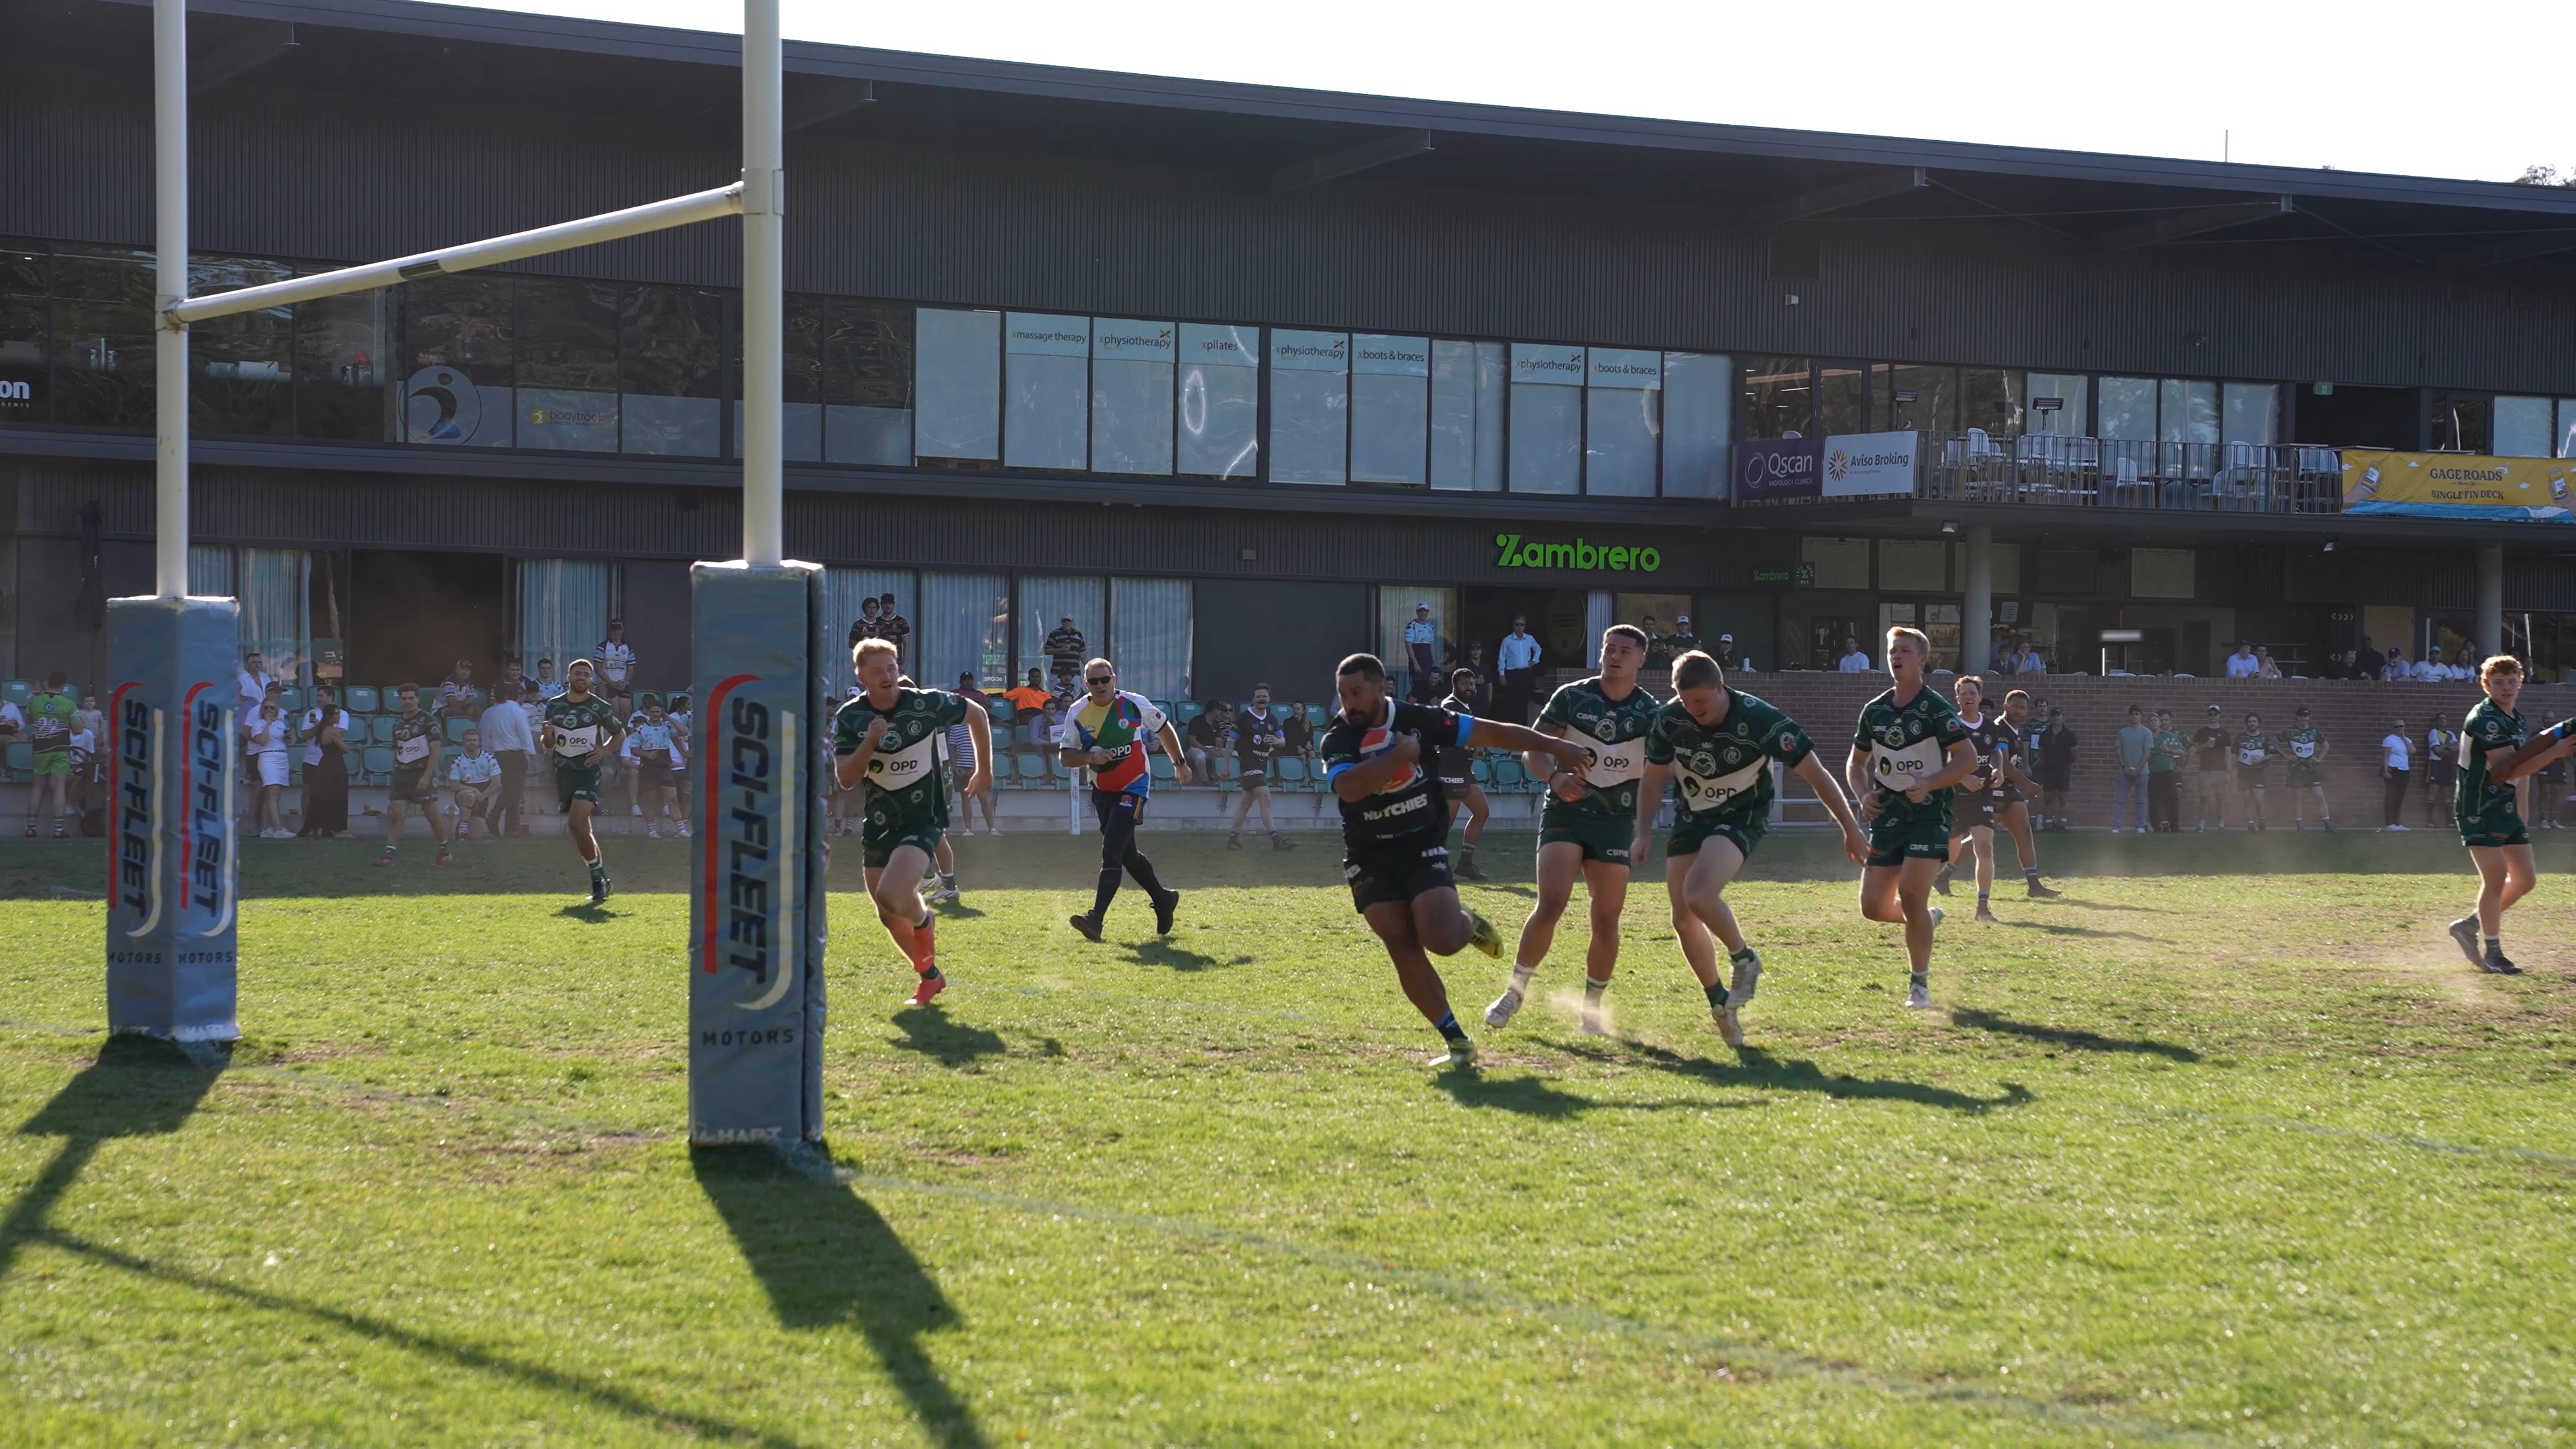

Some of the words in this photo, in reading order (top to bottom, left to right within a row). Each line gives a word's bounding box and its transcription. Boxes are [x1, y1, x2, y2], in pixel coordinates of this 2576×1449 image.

[1055, 331, 1087, 344] therapy
[1389, 351, 1396, 360] &
[1397, 350, 1425, 362] braces
[1622, 364, 1630, 374] &
[1631, 363, 1657, 376] braces
[1768, 452, 1813, 478] Qscan
[1850, 453, 1873, 467] Aviso
[1876, 451, 1909, 467] Broking
[2430, 468, 2462, 480] GAGE
[2463, 470, 2503, 481] ROADS
[2431, 490, 2463, 499] SINGLE
[2465, 490, 2479, 499] FIN
[2480, 490, 2504, 500] DECK
[1496, 534, 1661, 572] Zambrero
[1754, 571, 1789, 581] Zambrero
[1576, 712, 1599, 722] CBRE
[1110, 745, 1132, 757] OPD
[1676, 747, 1693, 757] BRE
[890, 760, 918, 771] OPD
[1603, 756, 1629, 768] OPD
[1896, 760, 1923, 771] OPD
[123, 698, 148, 918] SCI-FLEET
[194, 699, 220, 918] SCI-FLEET
[730, 696, 769, 984] SCI-FLEET
[1606, 849, 1629, 858] CBRE
[178, 950, 233, 965] MOTORS
[702, 1028, 794, 1046] MOTORS
